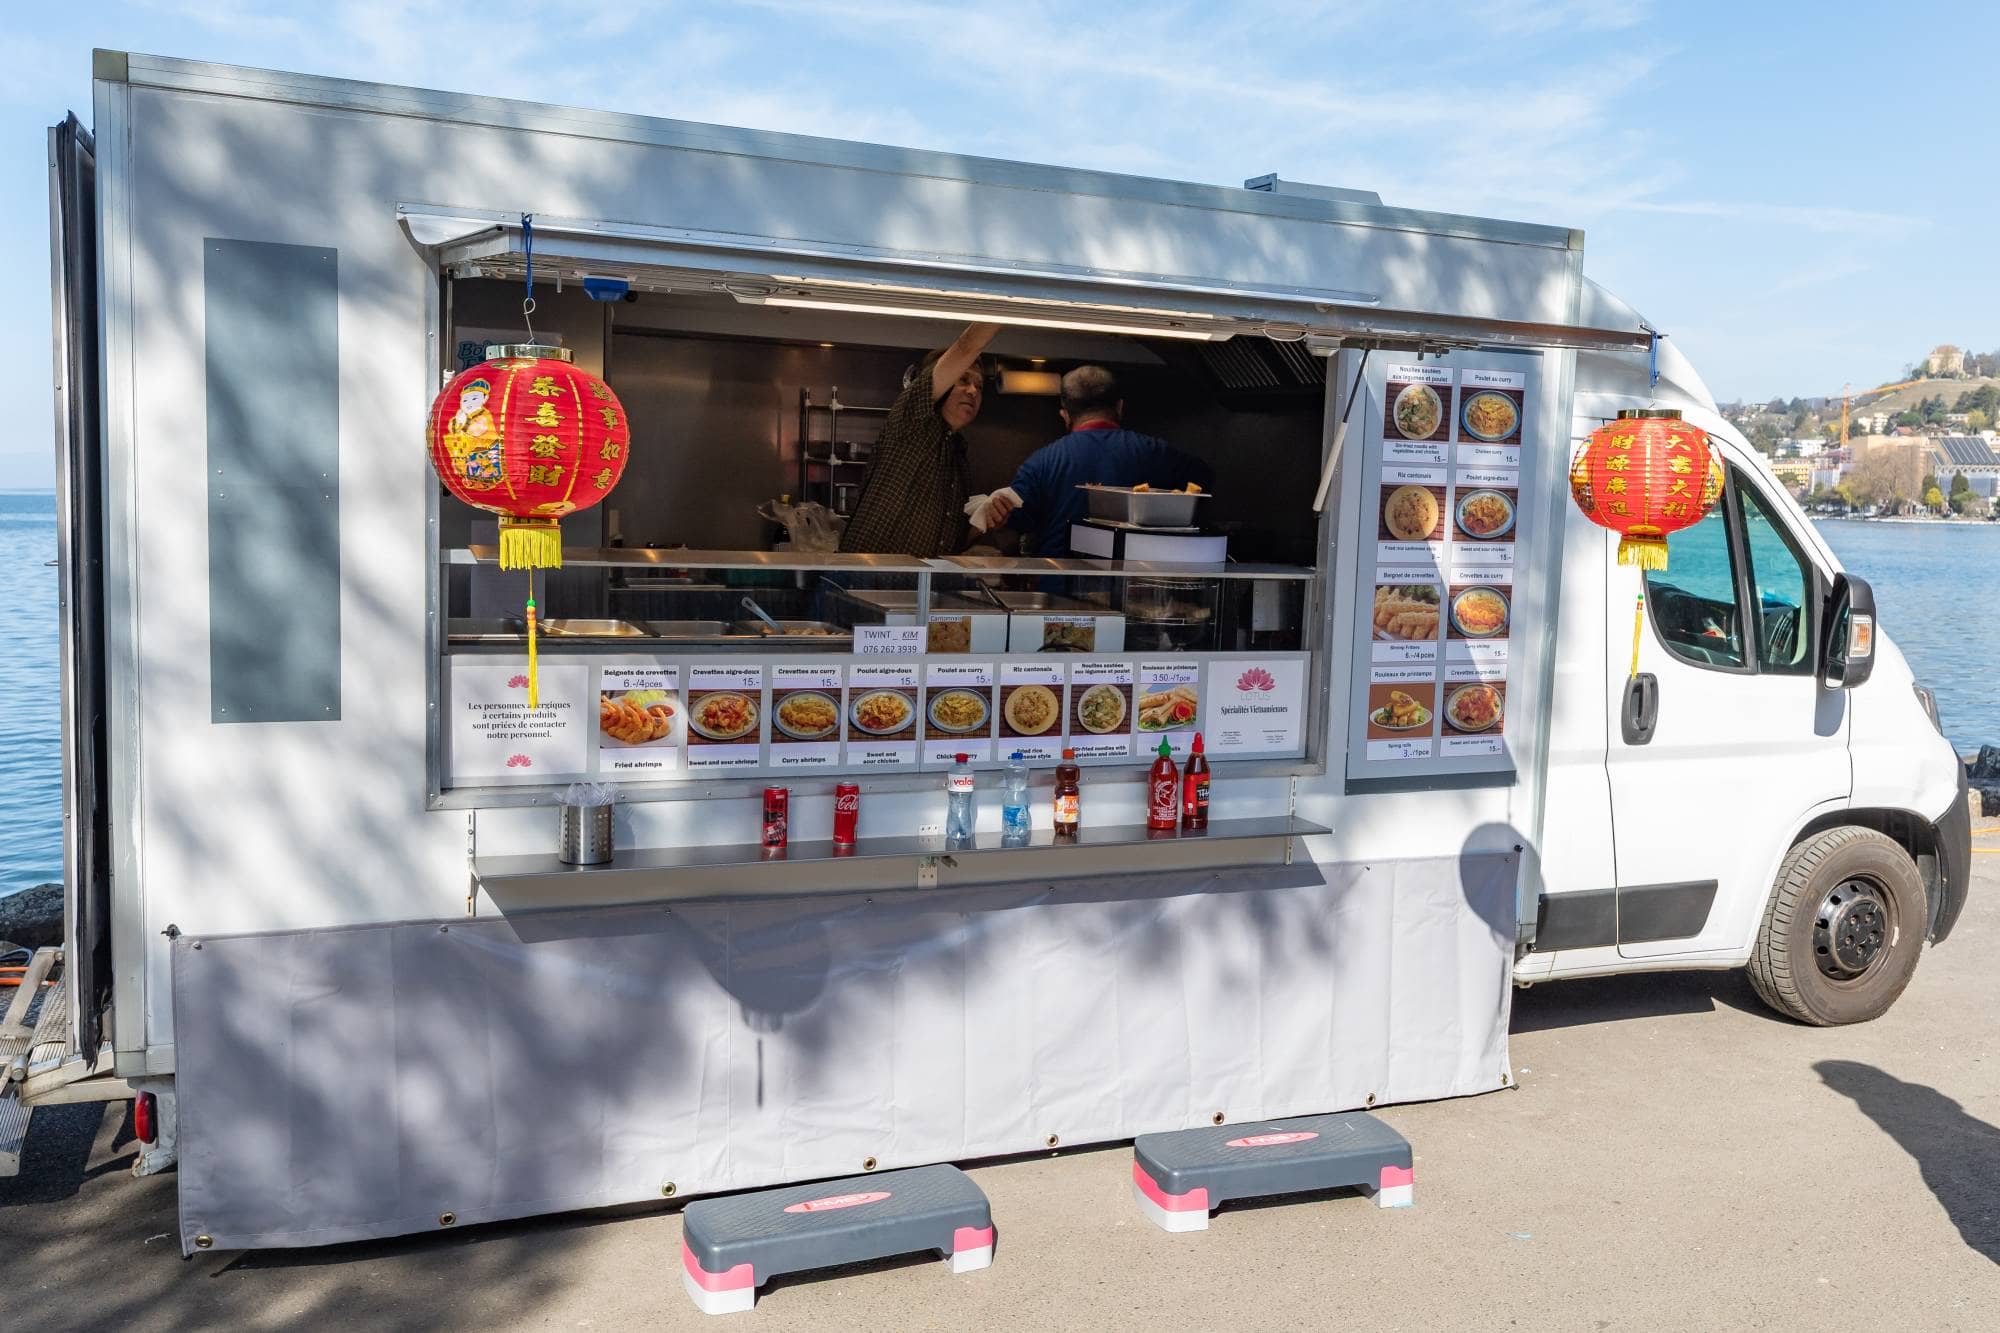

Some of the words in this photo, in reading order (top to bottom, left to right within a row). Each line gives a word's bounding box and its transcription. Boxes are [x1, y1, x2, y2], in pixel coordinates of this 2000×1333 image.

[623, 679, 663, 688] 6.-/4pces
[484, 703, 525, 711] personnes
[527, 702, 571, 711] alergiques
[523, 711, 557, 720] produits
[491, 722, 516, 730] priées
[510, 731, 552, 740] personnel.
